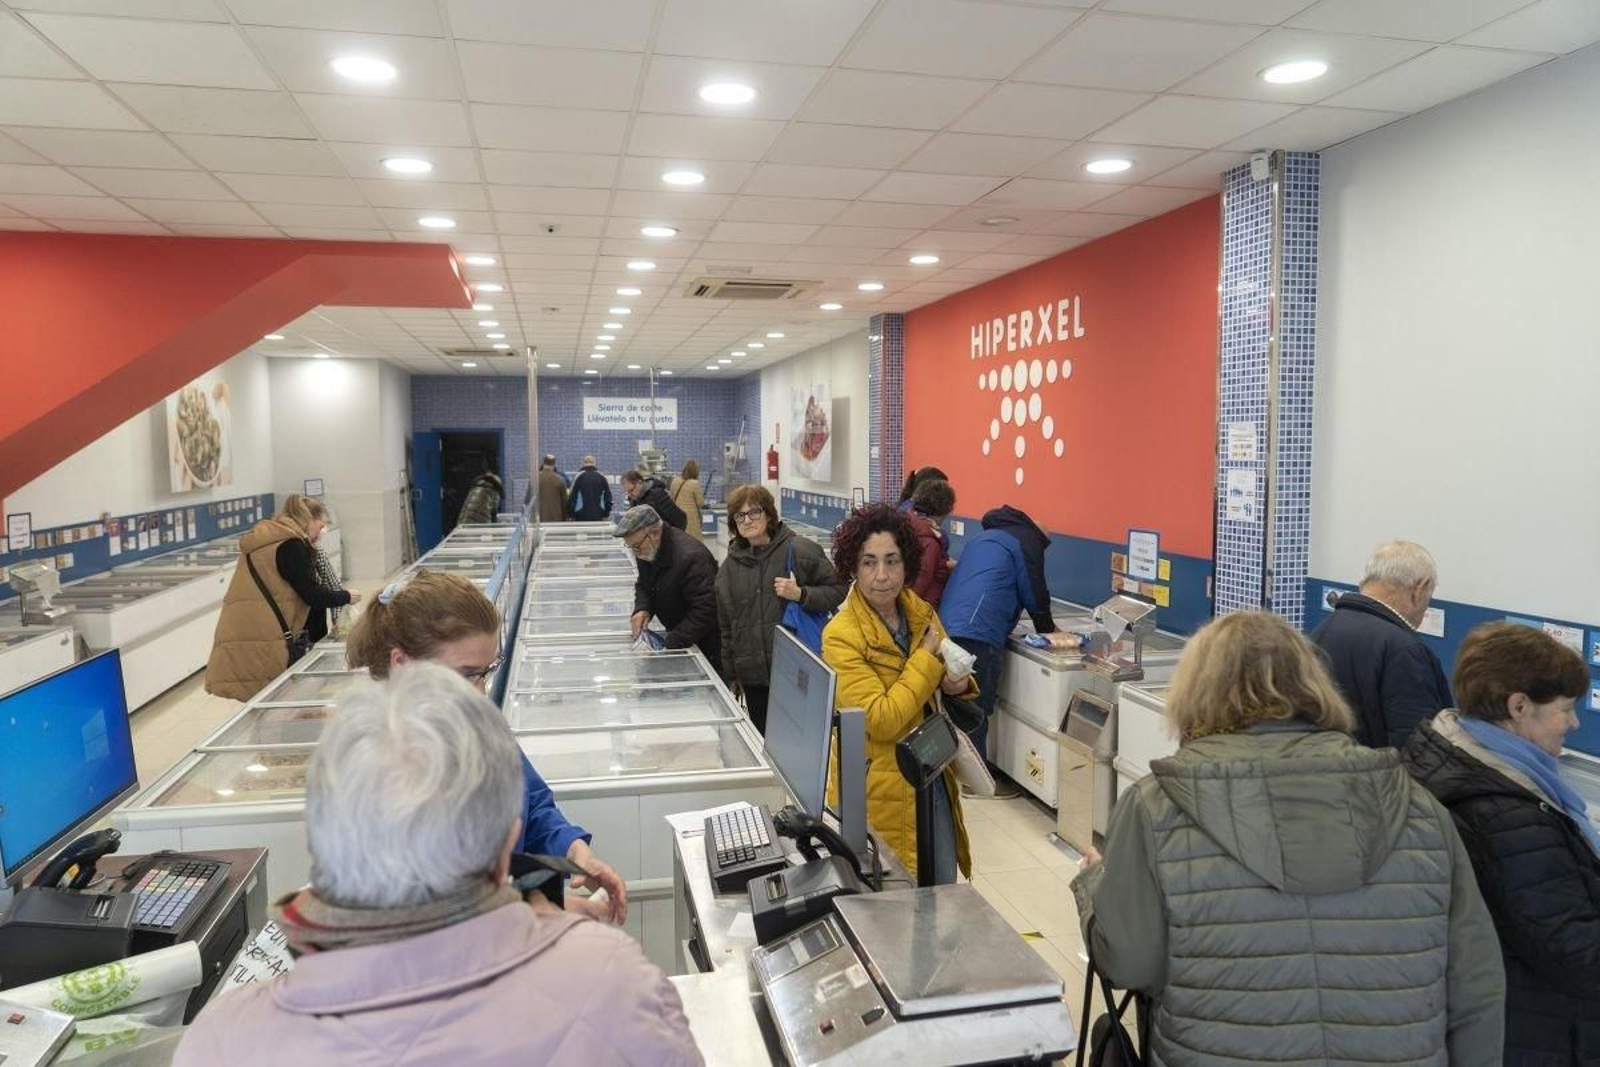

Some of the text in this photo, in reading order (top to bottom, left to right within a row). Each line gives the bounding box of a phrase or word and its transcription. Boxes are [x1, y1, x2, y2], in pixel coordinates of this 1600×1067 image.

[970, 295, 1085, 360] HIPERXEL
[598, 403, 624, 412] Sierra
[626, 403, 638, 412] de
[587, 414, 627, 423] Llévatelo
[638, 415, 646, 423] tu
